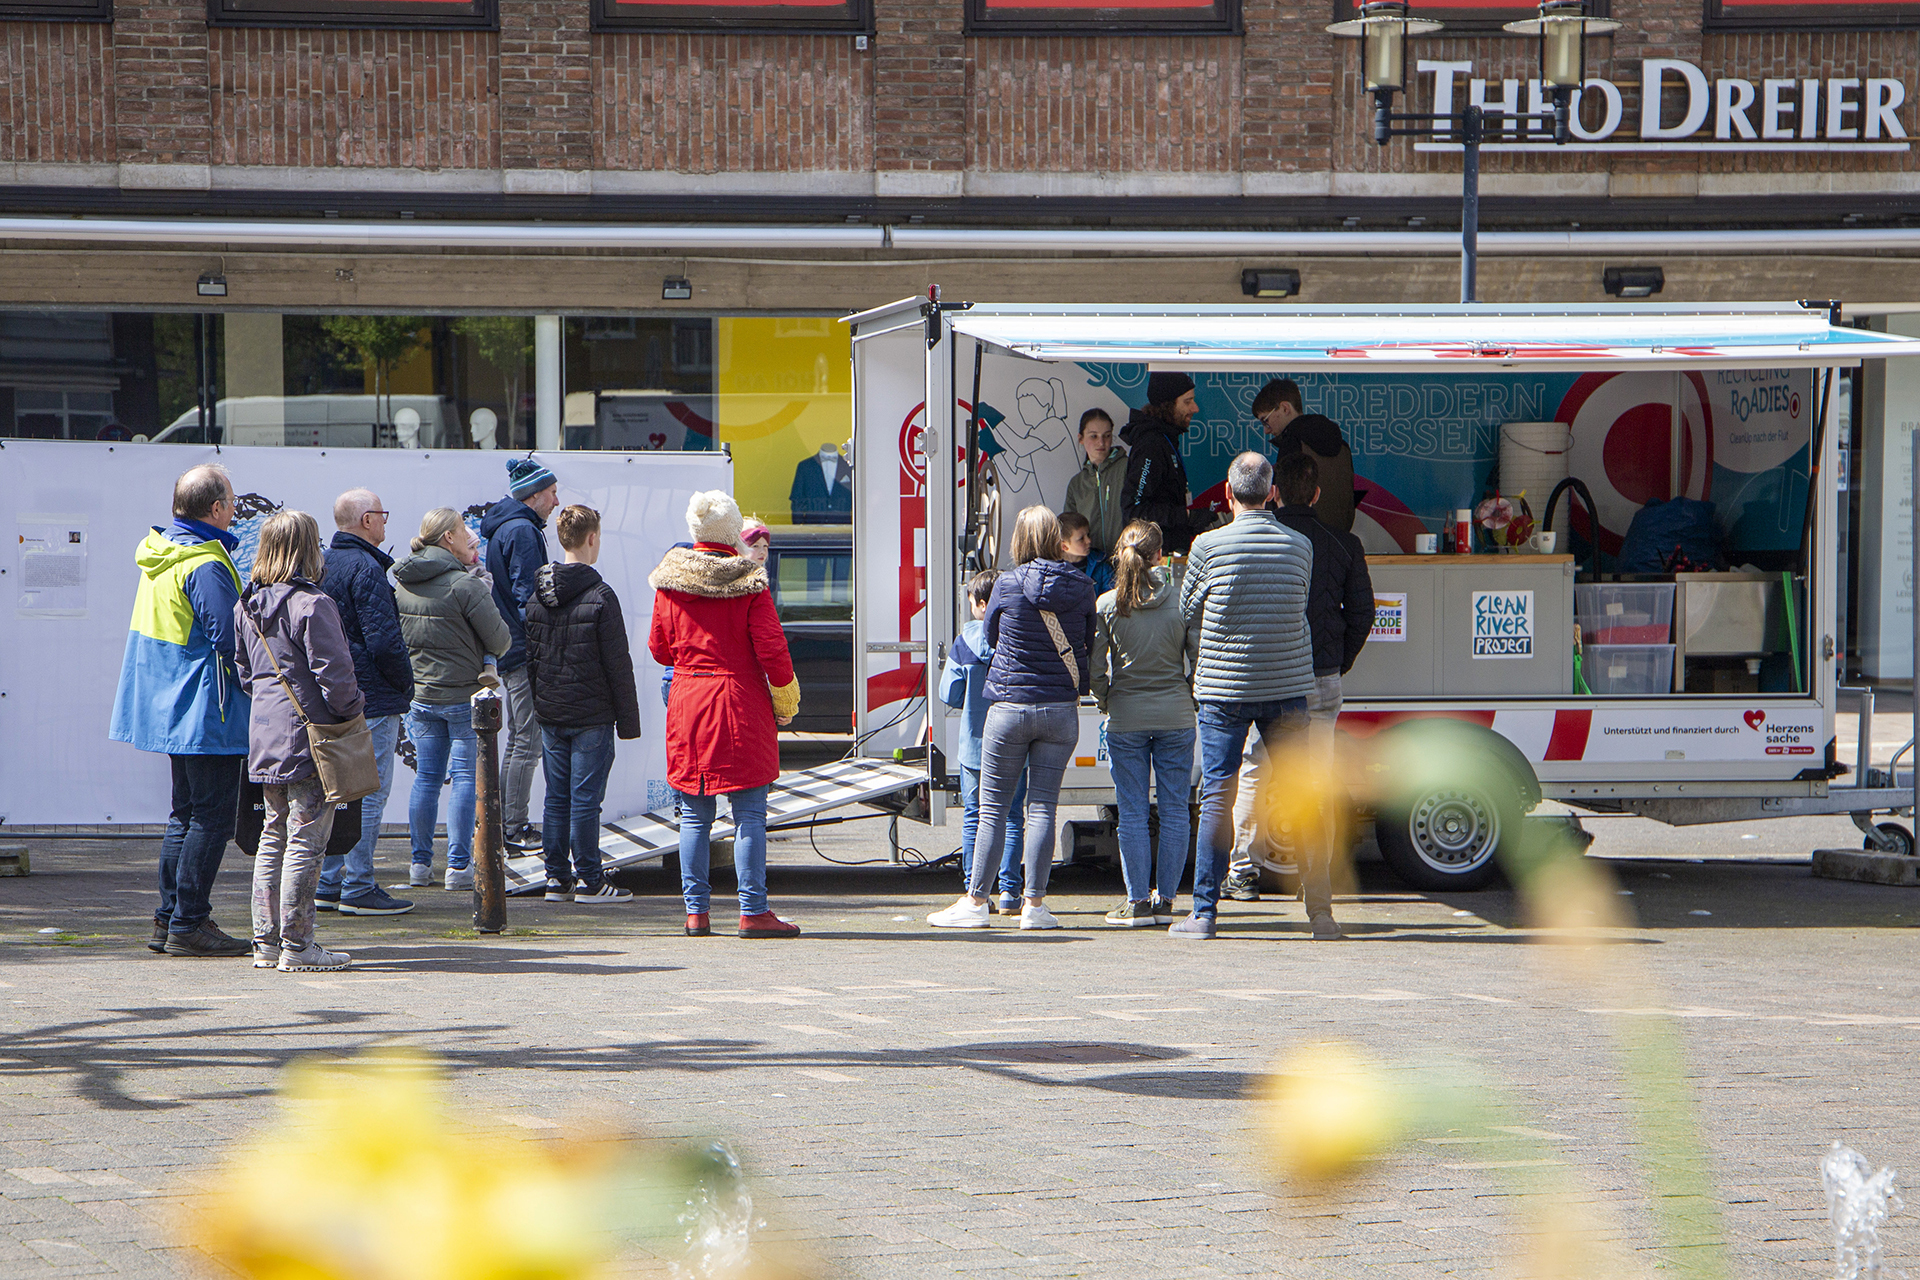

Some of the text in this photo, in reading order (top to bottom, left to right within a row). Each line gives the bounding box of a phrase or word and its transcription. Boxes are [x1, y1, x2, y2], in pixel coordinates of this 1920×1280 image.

[1639, 59, 1907, 140] DREIER
[1238, 383, 1545, 420] SHREDDERN
[1731, 384, 1789, 422] ROADIES
[1373, 617, 1402, 628] CODE
[1603, 726, 1740, 735] Unterstützt und finanziert durch
[1766, 724, 1815, 733] Herzens
[1766, 733, 1800, 743] sache
